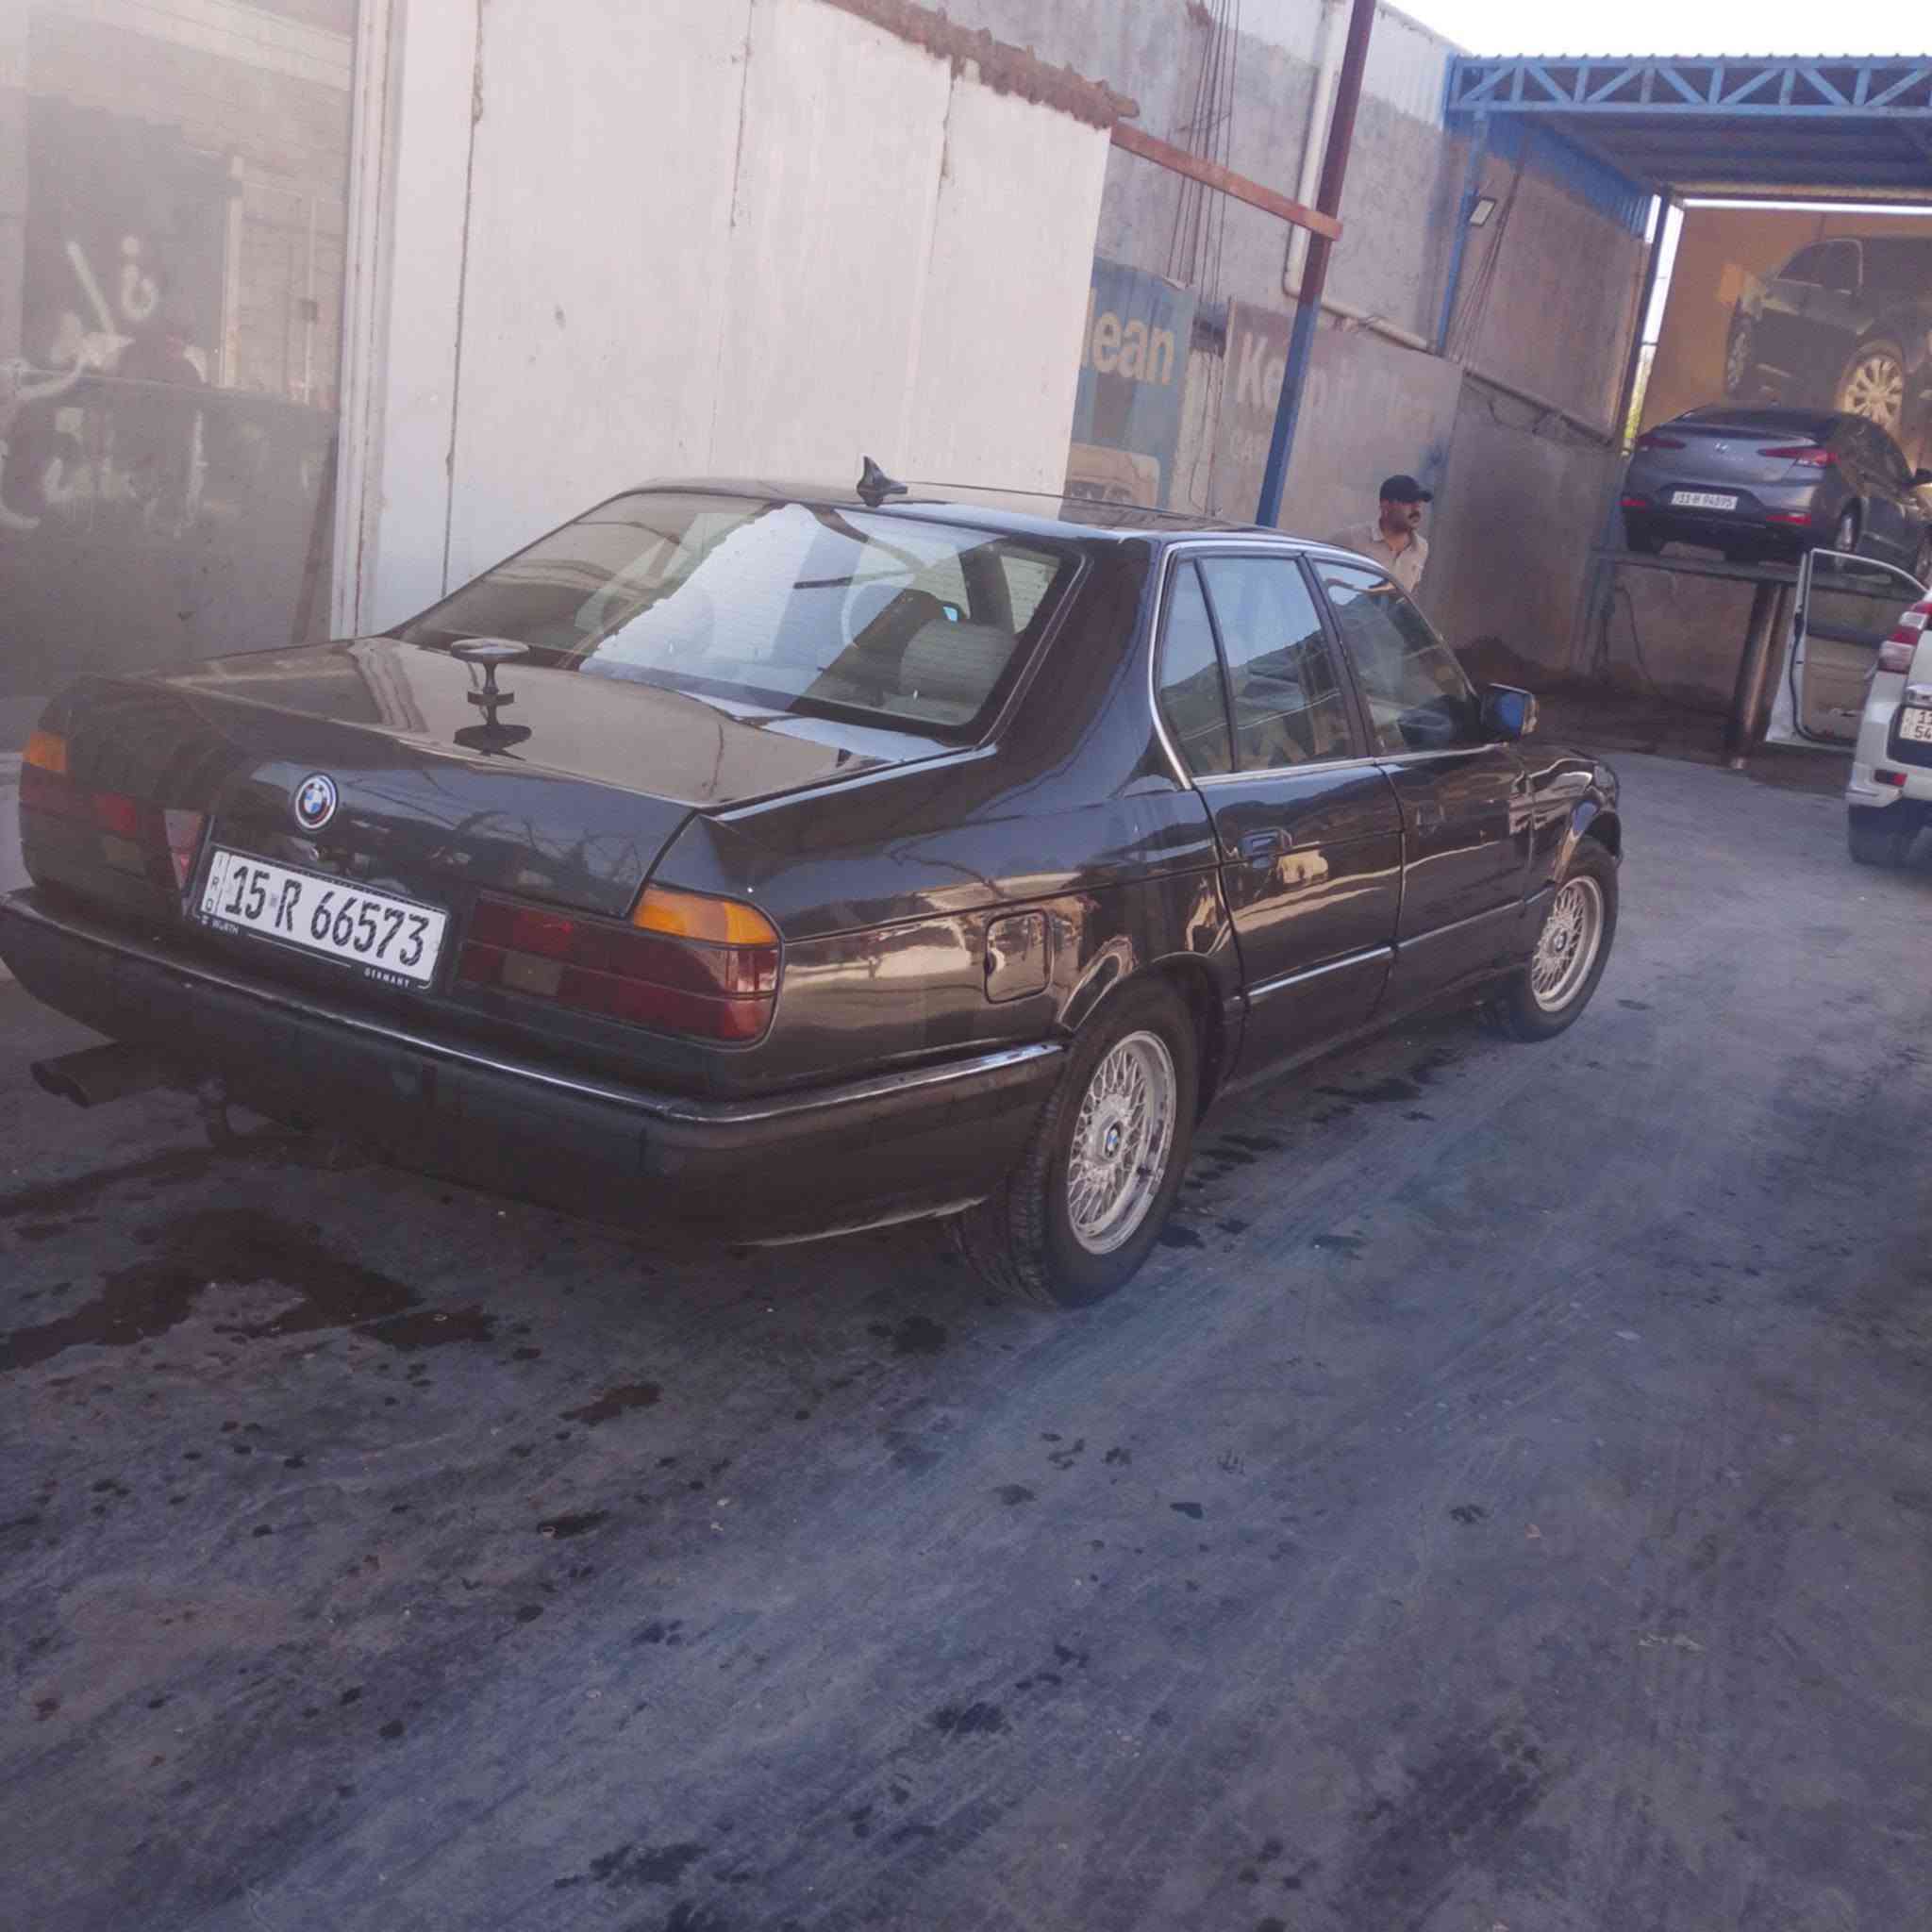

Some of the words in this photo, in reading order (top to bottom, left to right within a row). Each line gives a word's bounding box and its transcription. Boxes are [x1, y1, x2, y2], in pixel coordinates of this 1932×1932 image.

[1081, 287, 1174, 385] lean
[225, 865, 271, 921] 15
[275, 878, 303, 932] R
[310, 891, 430, 968] 66573
[363, 966, 410, 989] GERMANY
